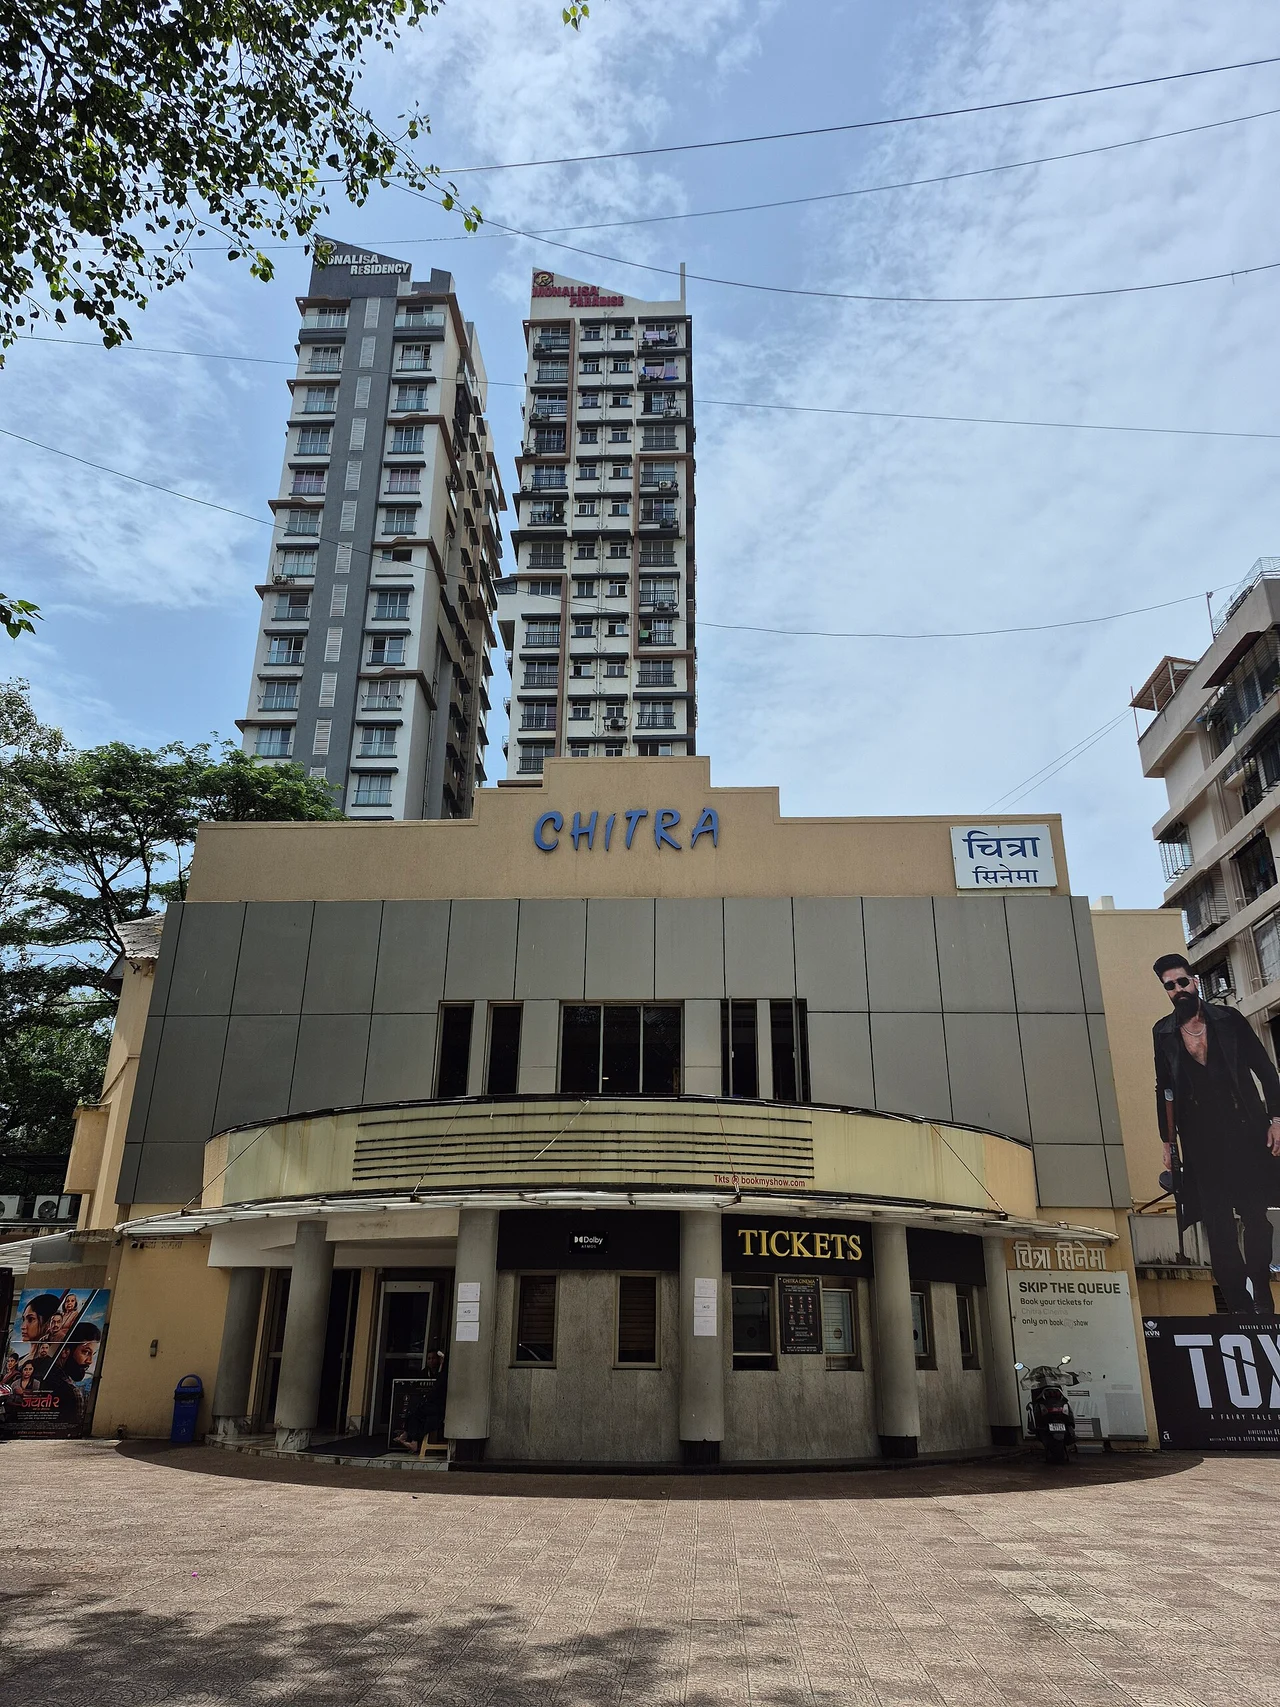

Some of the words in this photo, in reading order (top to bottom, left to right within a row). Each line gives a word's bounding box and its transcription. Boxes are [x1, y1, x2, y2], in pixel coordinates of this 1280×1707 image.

[315, 254, 379, 265] ONALISA
[350, 263, 410, 275] RESIDENCY
[532, 286, 600, 298] MONALISA
[569, 296, 624, 307] PARADISE
[533, 807, 719, 852] CHITRA
[961, 830, 1041, 859] चित्रा
[972, 863, 1039, 885] सिनेमा
[713, 1174, 730, 1184] Tkts
[741, 1176, 806, 1187] bookmyshow.com
[583, 1236, 604, 1245] Dolby
[738, 1229, 863, 1261] TICKETS
[1013, 1241, 1051, 1270] चित्रा
[1054, 1241, 1107, 1270] सिनेमा
[1018, 1282, 1048, 1293] SKIP
[1050, 1282, 1075, 1293] THE
[1077, 1283, 1121, 1294] QUEUE
[1057, 1298, 1082, 1306] tickets
[1083, 1298, 1094, 1306] for
[1022, 1318, 1038, 1327] only
[1144, 1330, 1160, 1338] KVN
[1251, 1413, 1272, 1421] TALE
